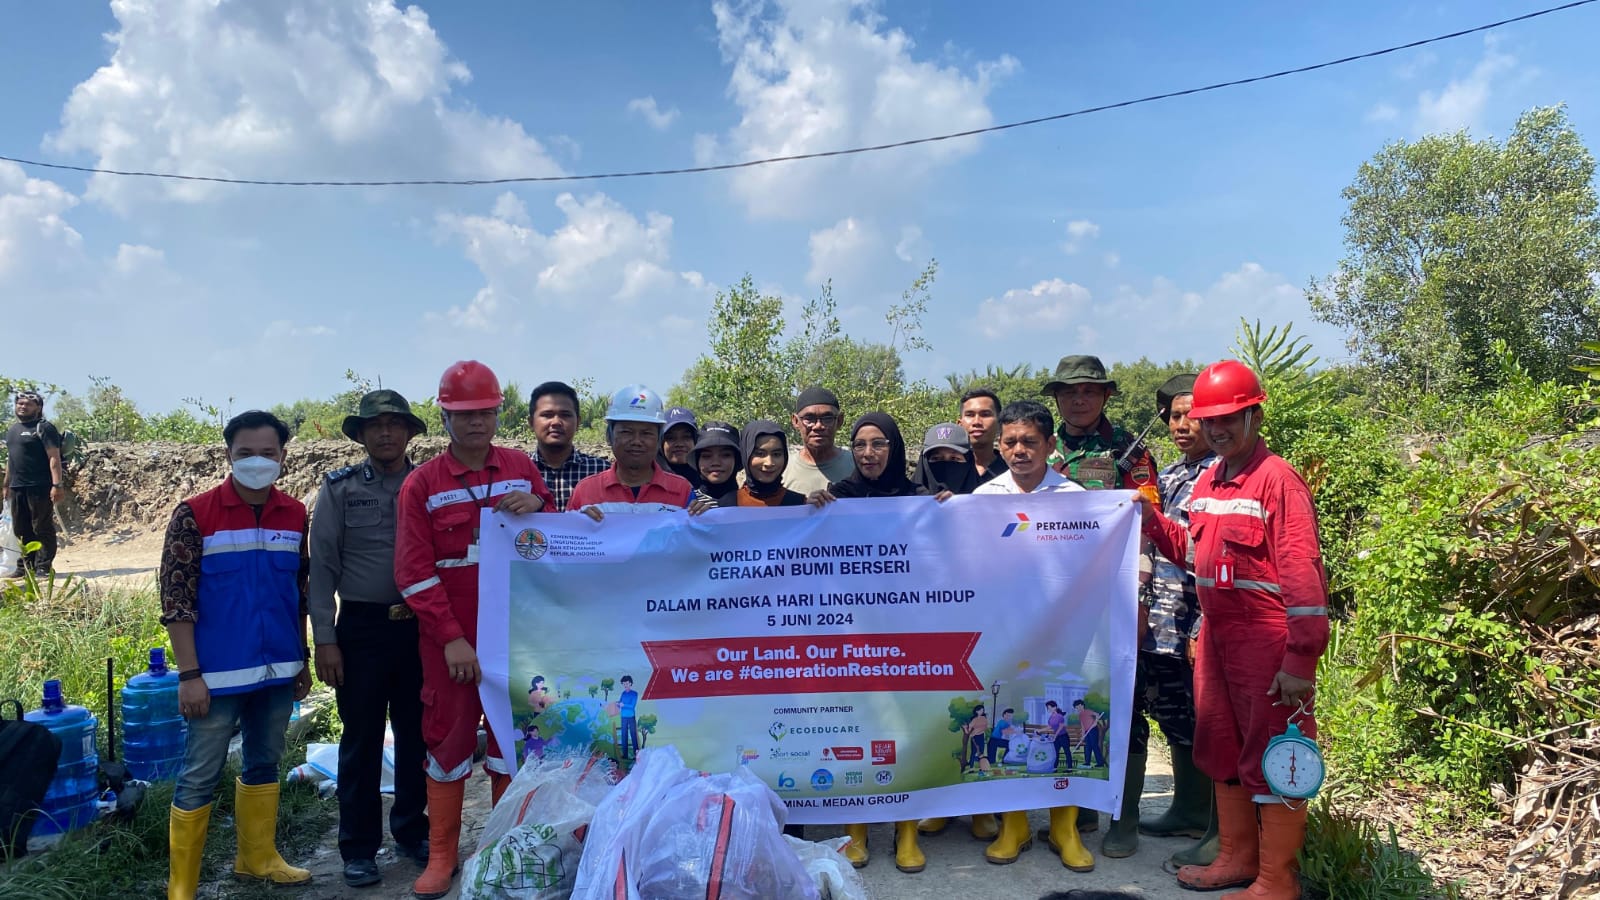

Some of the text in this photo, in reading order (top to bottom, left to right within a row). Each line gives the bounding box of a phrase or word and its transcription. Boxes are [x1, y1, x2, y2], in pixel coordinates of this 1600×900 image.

[1036, 520, 1100, 531] PERTAMINA
[710, 543, 908, 563] WORLD ENVIRONMENT DAY
[708, 559, 910, 581] GERAKAN BUMI BERSERI
[646, 590, 975, 613] DALAM RANGKA HARI LINGKUNGAN HIDUP
[767, 612, 854, 627] 5 JUNI 2024
[716, 642, 906, 663] Our Land. Our Future.
[670, 659, 954, 684] We are #GenerationRestoration
[773, 705, 854, 715] COMMUNITY PARTNER
[790, 725, 861, 735] ECOEDUCARE
[822, 797, 864, 807] MEDAN
[868, 793, 910, 805] GROUP
